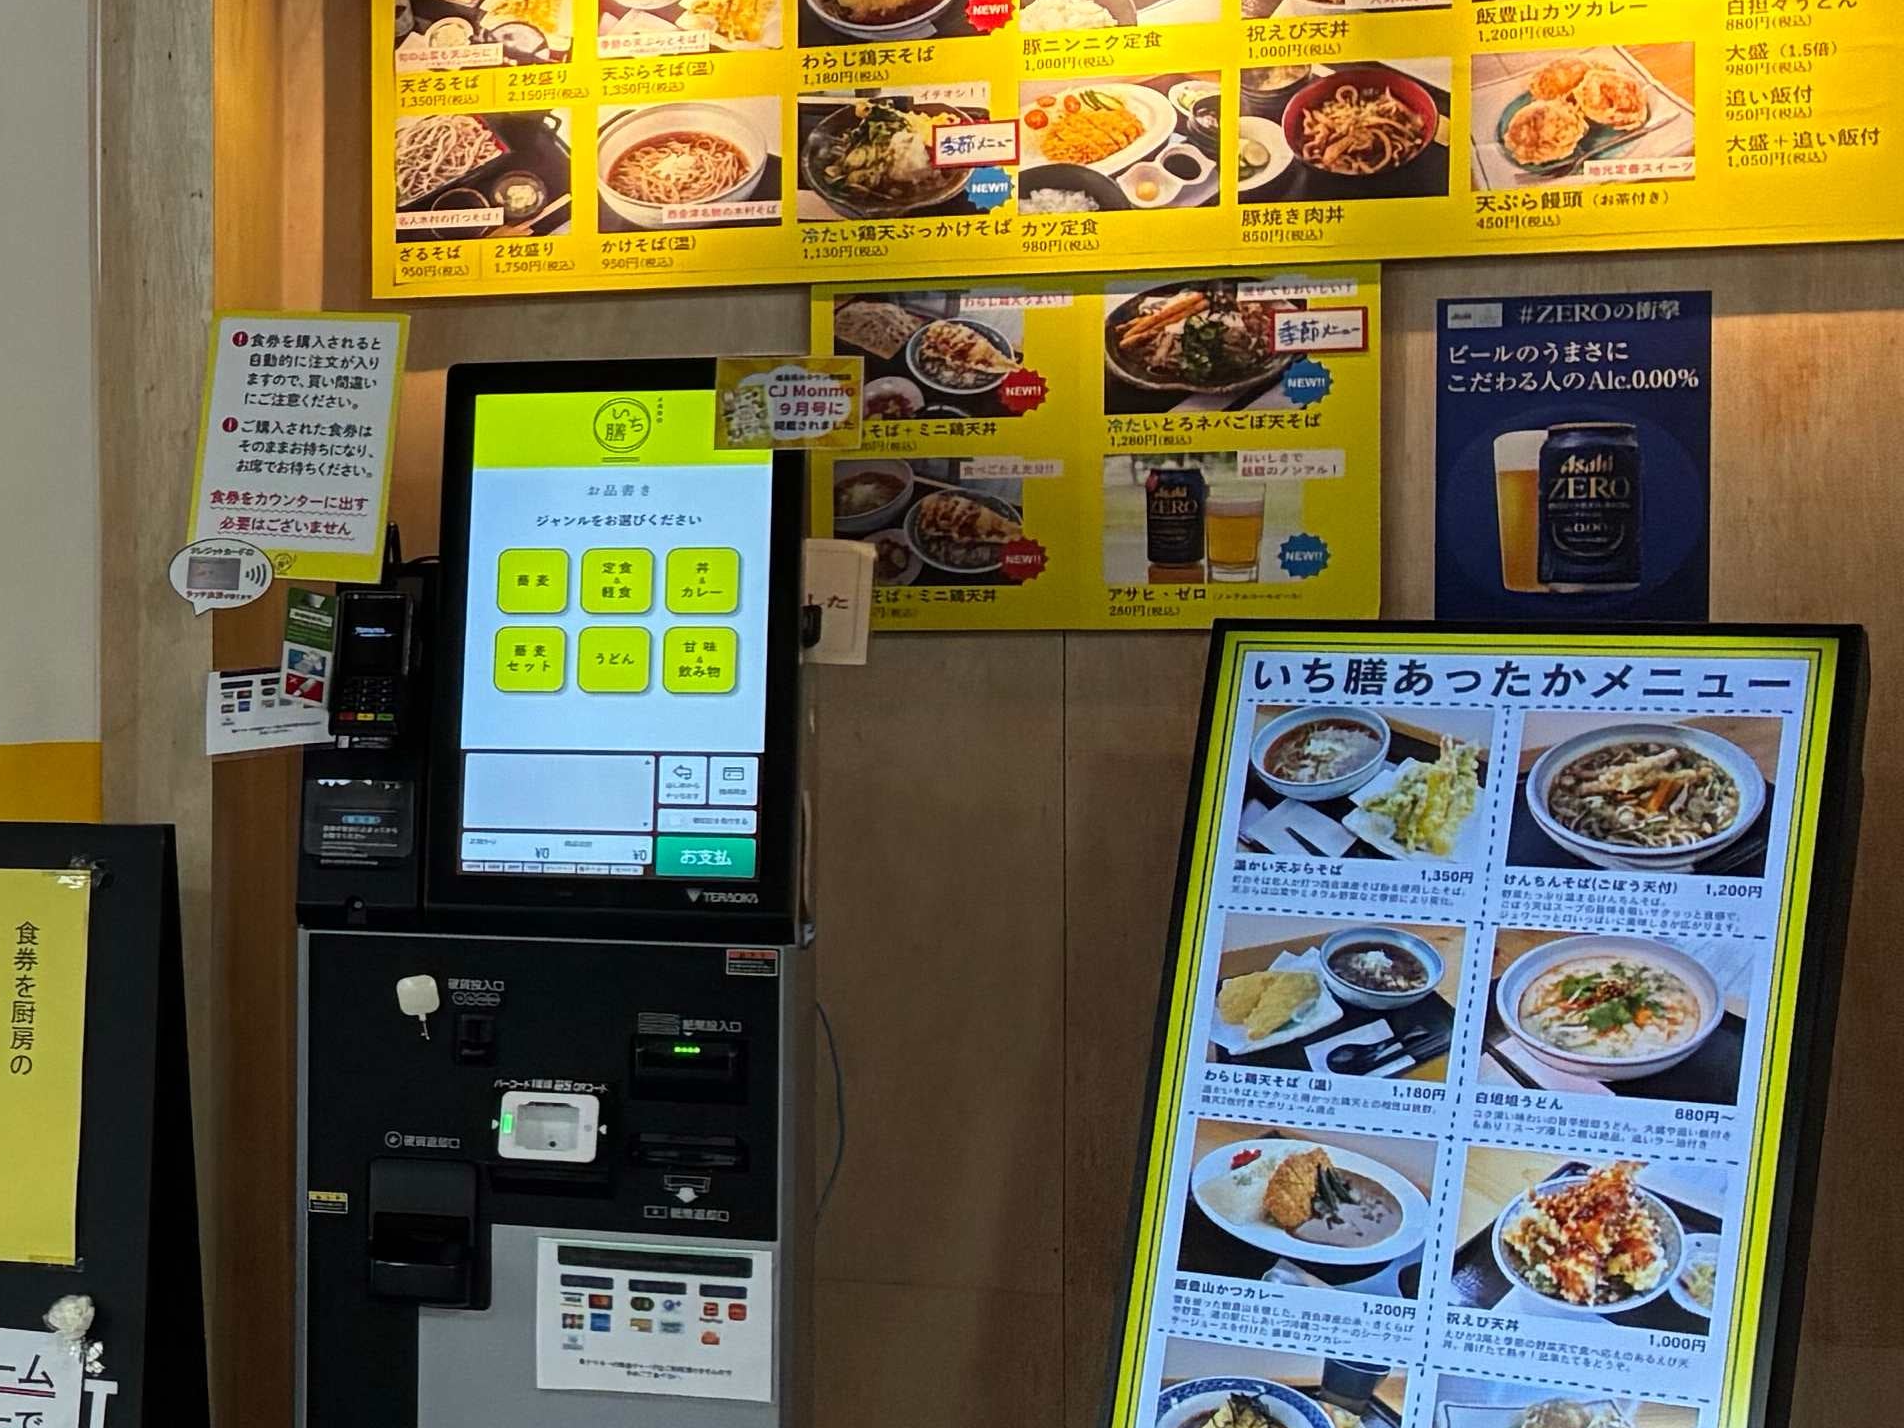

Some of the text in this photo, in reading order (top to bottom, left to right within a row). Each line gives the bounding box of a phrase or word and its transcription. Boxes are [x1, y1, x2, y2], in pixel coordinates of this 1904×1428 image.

[1476, 2, 1647, 24] 飯豊山カツカレー
[1247, 20, 1349, 42] 祝えび天丼
[1023, 32, 1162, 55] 豚ニンニク定食
[1727, 44, 1769, 61] 大盛
[802, 45, 934, 69] わらじ鶏天そば
[401, 71, 568, 93] 天ざるそば 2枚盛り
[1727, 84, 1813, 107] 追い飯付
[1476, 192, 1582, 213] 天ぷら饅頭
[1241, 207, 1344, 226] 豚焼き肉丼
[802, 218, 1011, 243] 冷たい鶏天ぶっかけそば
[1021, 220, 1098, 237] カツ定食
[401, 242, 554, 261] ざるそば 2枚盛り
[251, 333, 381, 350] 食券を購入されると
[249, 353, 378, 369] 自動的に注文が入り
[1449, 342, 1629, 364] ビールのうまさに
[246, 373, 376, 390] ますので、買い間違い
[1287, 378, 1325, 388] NEW!!
[794, 385, 855, 397] Monmo
[244, 393, 358, 410] にご注意ください。
[241, 419, 371, 438] ご購入された食券は
[1108, 414, 1321, 433] 冷たいとろネバごぼ天そば
[239, 439, 374, 459] そのままお持ちになり、
[236, 459, 373, 478] お席でお待ちください。
[586, 484, 652, 497] お品書き
[1548, 476, 1630, 499] ZERO
[210, 489, 367, 511] 食券をカウンターに出す
[219, 516, 352, 536] 必要はございません
[535, 513, 702, 528] ジャンルをお選びください
[602, 562, 632, 575] 定食
[696, 562, 710, 574] 丼
[602, 586, 632, 599] 軽食
[681, 587, 722, 599] カレー
[1109, 588, 1206, 601] アサヒ・ゼロ
[507, 661, 551, 673] セット
[596, 652, 634, 665] うどん
[678, 665, 720, 679] 飲み物
[1255, 657, 1790, 699] いち膳あったかメニュー
[681, 850, 731, 865] お支払
[1421, 870, 1473, 885] 1,350円
[1706, 884, 1762, 898] 1,200円
[10, 921, 39, 1075] 食券を厨房の
[1204, 1070, 1298, 1088] わらじ鶏天そば
[1392, 1085, 1445, 1101] 1,180円
[1175, 1278, 1284, 1300] 飯豊山かつカレー
[1362, 1301, 1416, 1320] 1,200円
[1447, 1312, 1519, 1332] 祝えび天丼
[1649, 1334, 1706, 1352] 1,000円
